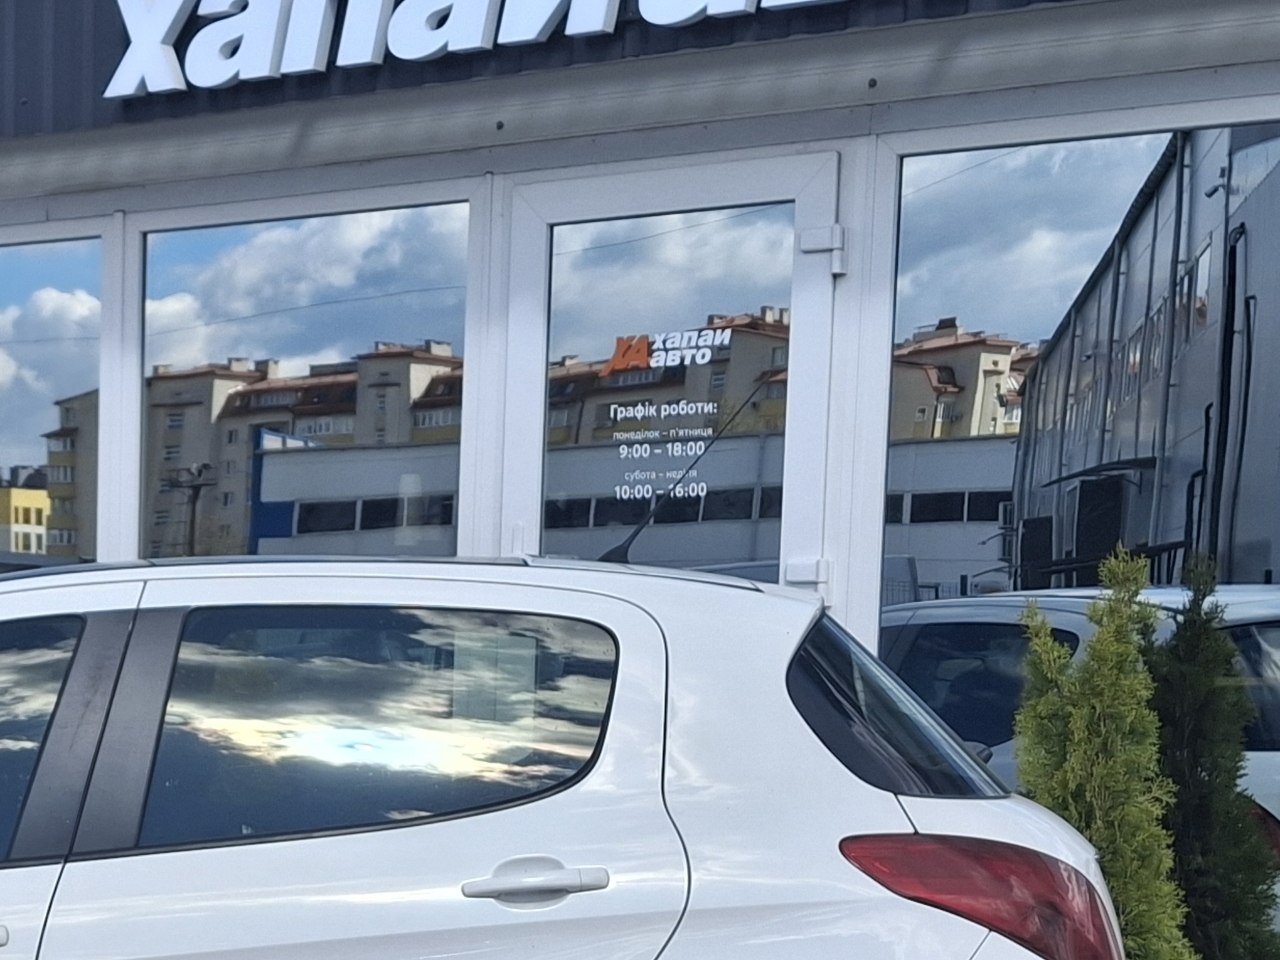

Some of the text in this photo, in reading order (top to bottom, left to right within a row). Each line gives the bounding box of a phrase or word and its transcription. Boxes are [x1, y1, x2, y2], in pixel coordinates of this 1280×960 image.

[649, 347, 712, 368] авто
[610, 400, 718, 421] Графік роботи:
[613, 428, 660, 440] понеділок
[619, 443, 650, 459] 9:00
[666, 441, 706, 457] 18:00
[624, 469, 656, 482] субота
[614, 484, 653, 500] 10:00
